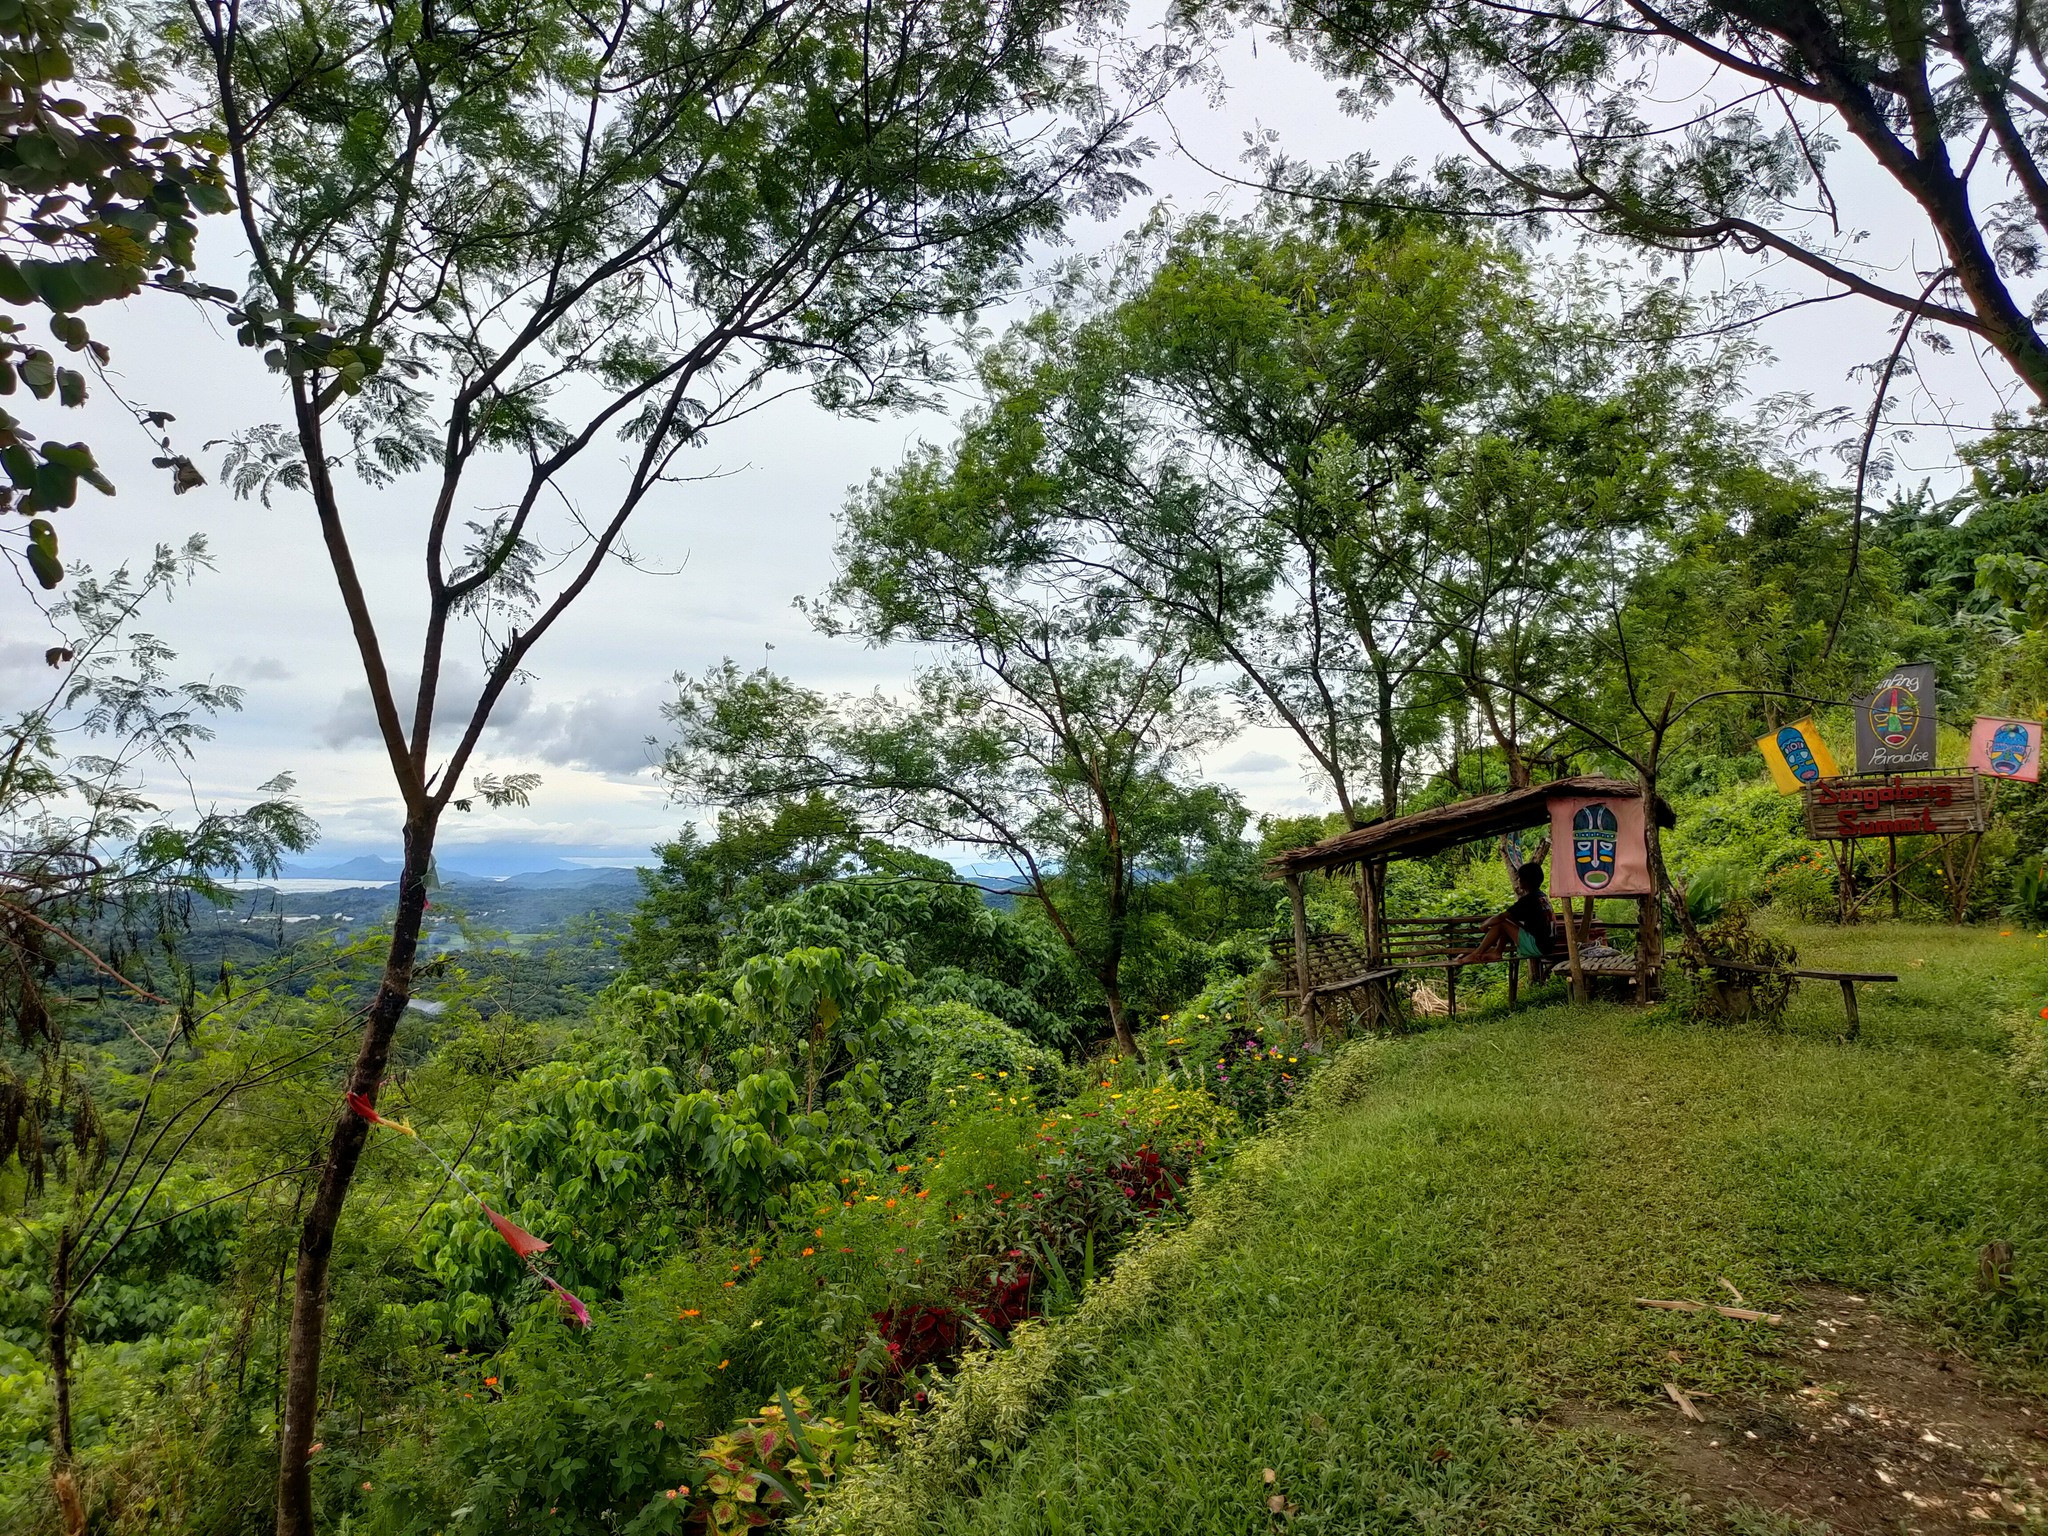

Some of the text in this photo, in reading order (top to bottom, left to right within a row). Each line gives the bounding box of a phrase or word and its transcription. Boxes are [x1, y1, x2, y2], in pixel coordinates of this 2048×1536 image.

[1875, 673, 1920, 692] mping
[1868, 744, 1929, 766] Paradise
[1818, 774, 1953, 810] Singalong
[1837, 806, 1937, 835] Summit
